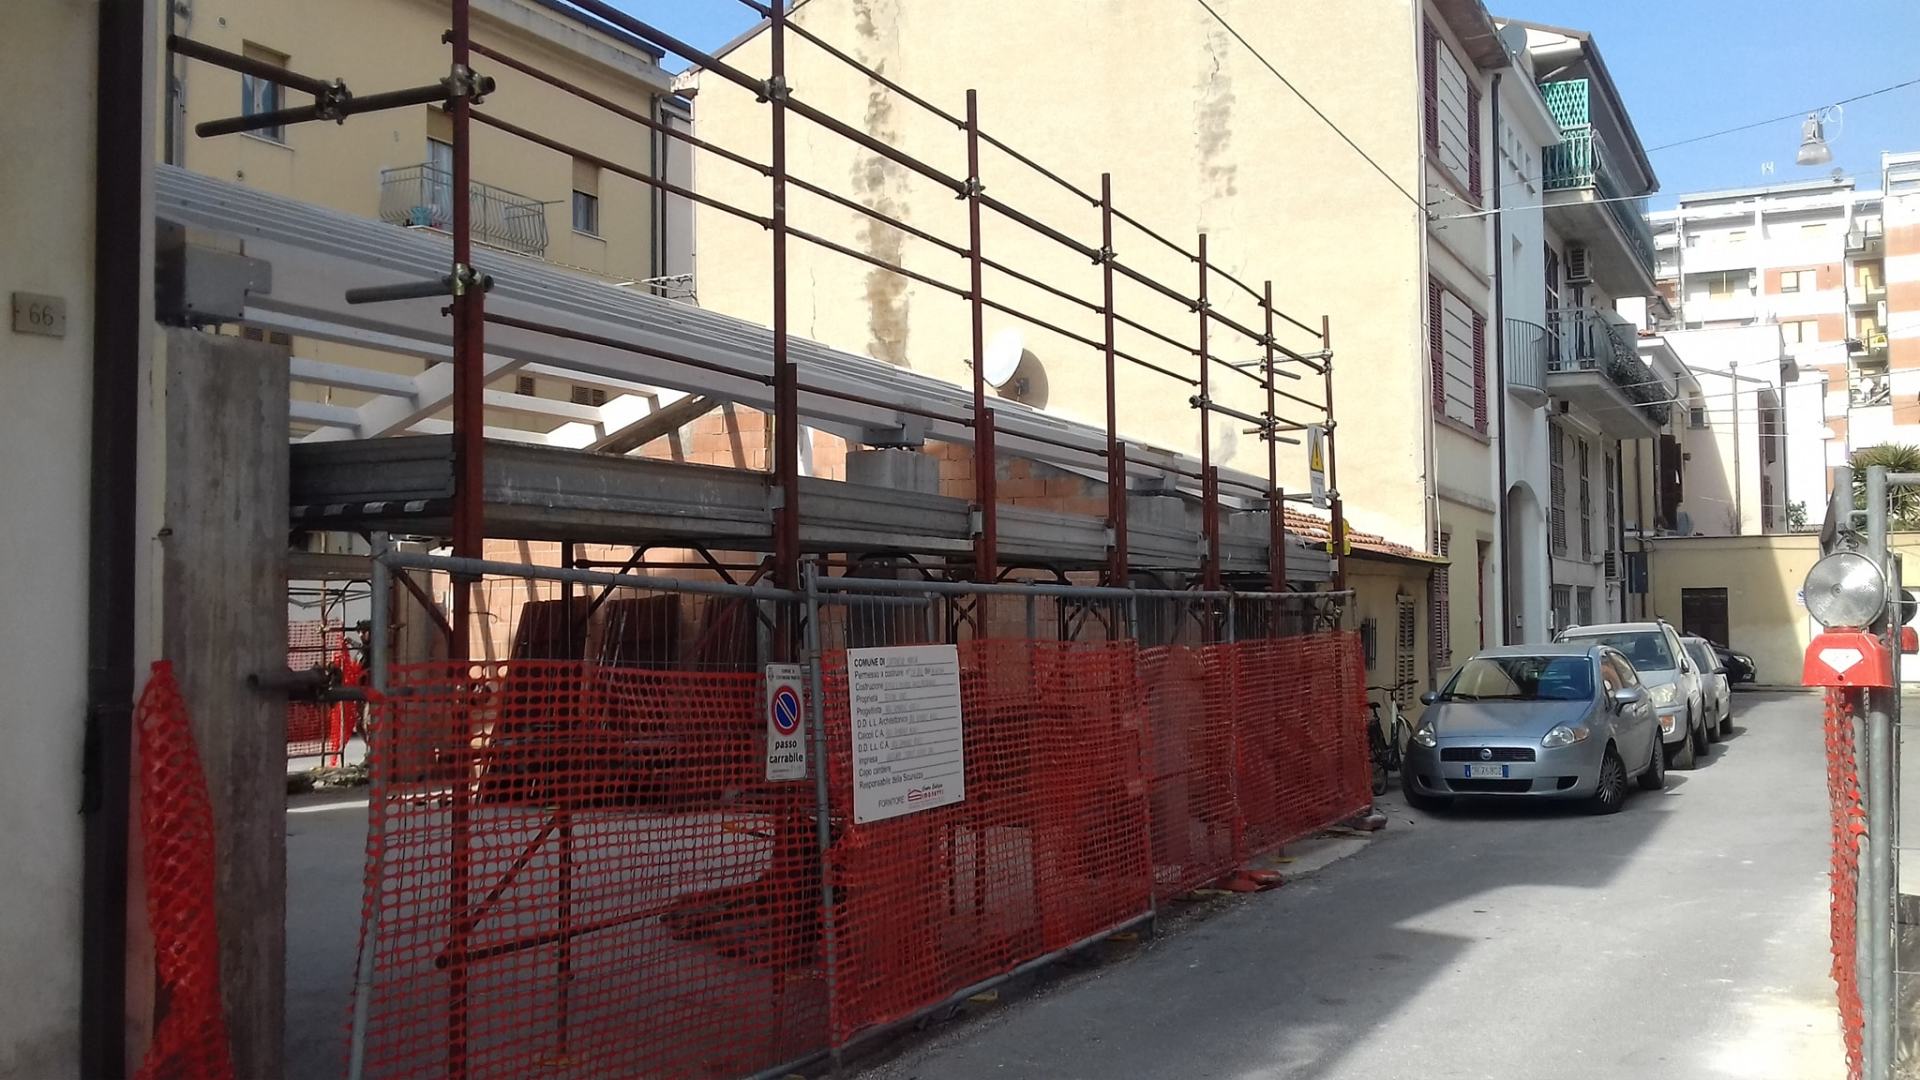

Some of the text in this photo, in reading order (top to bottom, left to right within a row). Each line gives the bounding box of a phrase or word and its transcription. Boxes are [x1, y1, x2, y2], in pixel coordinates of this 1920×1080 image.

[29, 302, 54, 327] 66
[854, 658, 878, 668] COMUNE
[879, 657, 886, 666] DI
[775, 740, 798, 750] passo
[769, 752, 804, 763] carrabile
